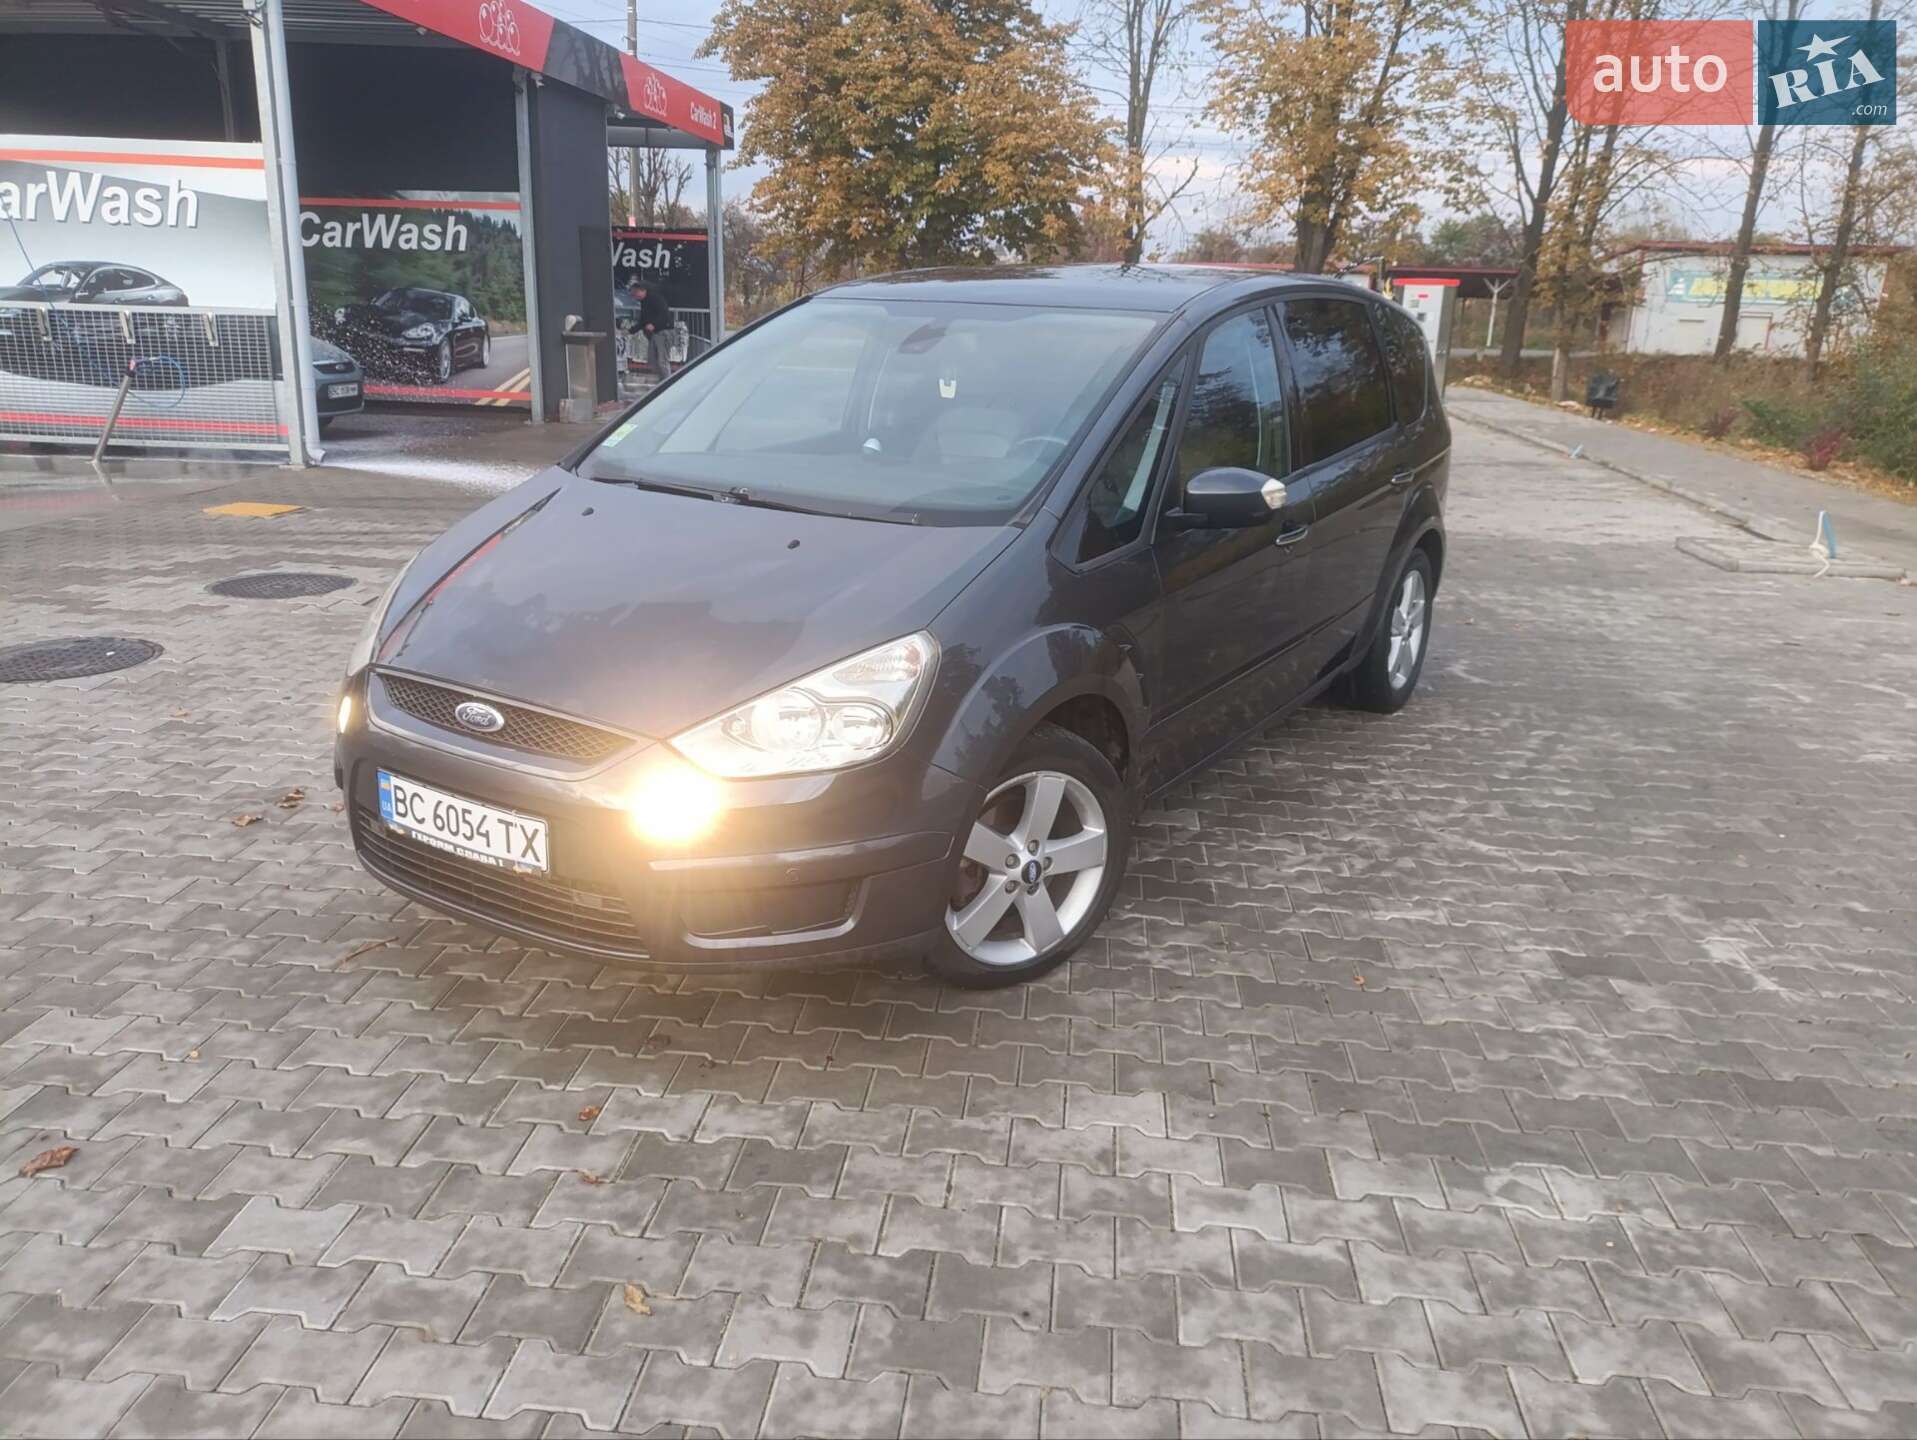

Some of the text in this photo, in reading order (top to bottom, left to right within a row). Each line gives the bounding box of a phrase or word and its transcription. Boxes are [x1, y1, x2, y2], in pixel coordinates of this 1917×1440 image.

[690, 101, 712, 128] CarWash
[299, 210, 468, 252] CarWash
[462, 706, 492, 726] Ford
[382, 801, 393, 812] UA
[393, 784, 541, 863] BC 6054 TX
